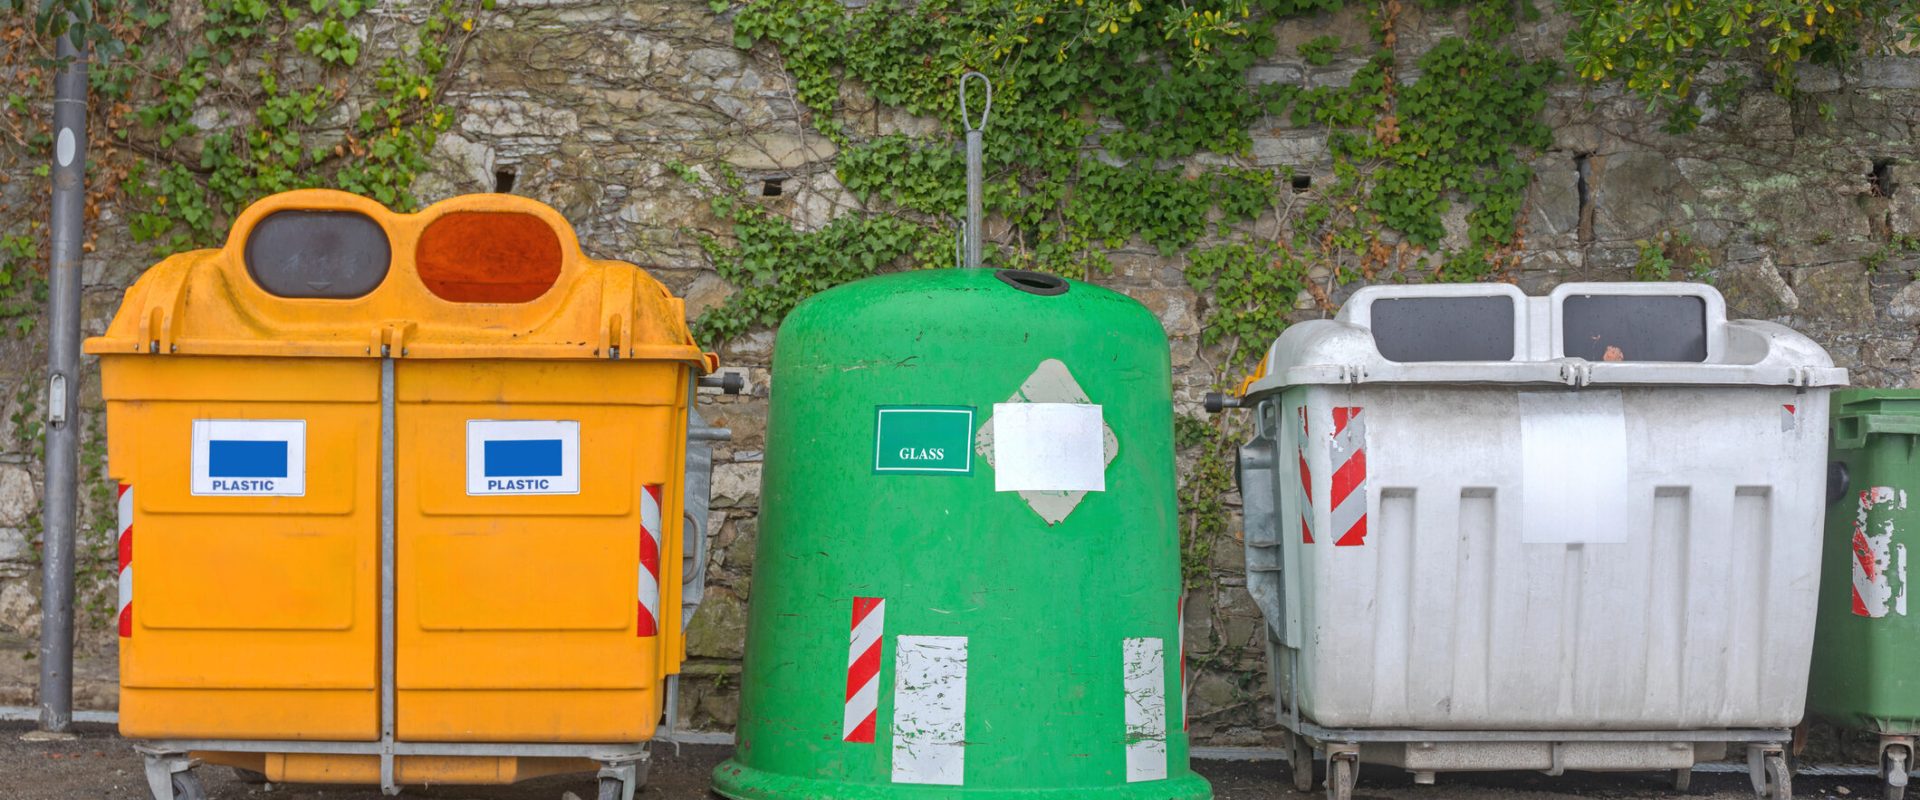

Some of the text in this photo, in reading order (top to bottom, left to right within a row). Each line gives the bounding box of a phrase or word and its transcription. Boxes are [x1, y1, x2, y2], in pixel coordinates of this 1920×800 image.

[899, 448, 944, 460] GLASS
[212, 480, 274, 491] PLASTIC
[488, 480, 549, 490] PLASTIC
